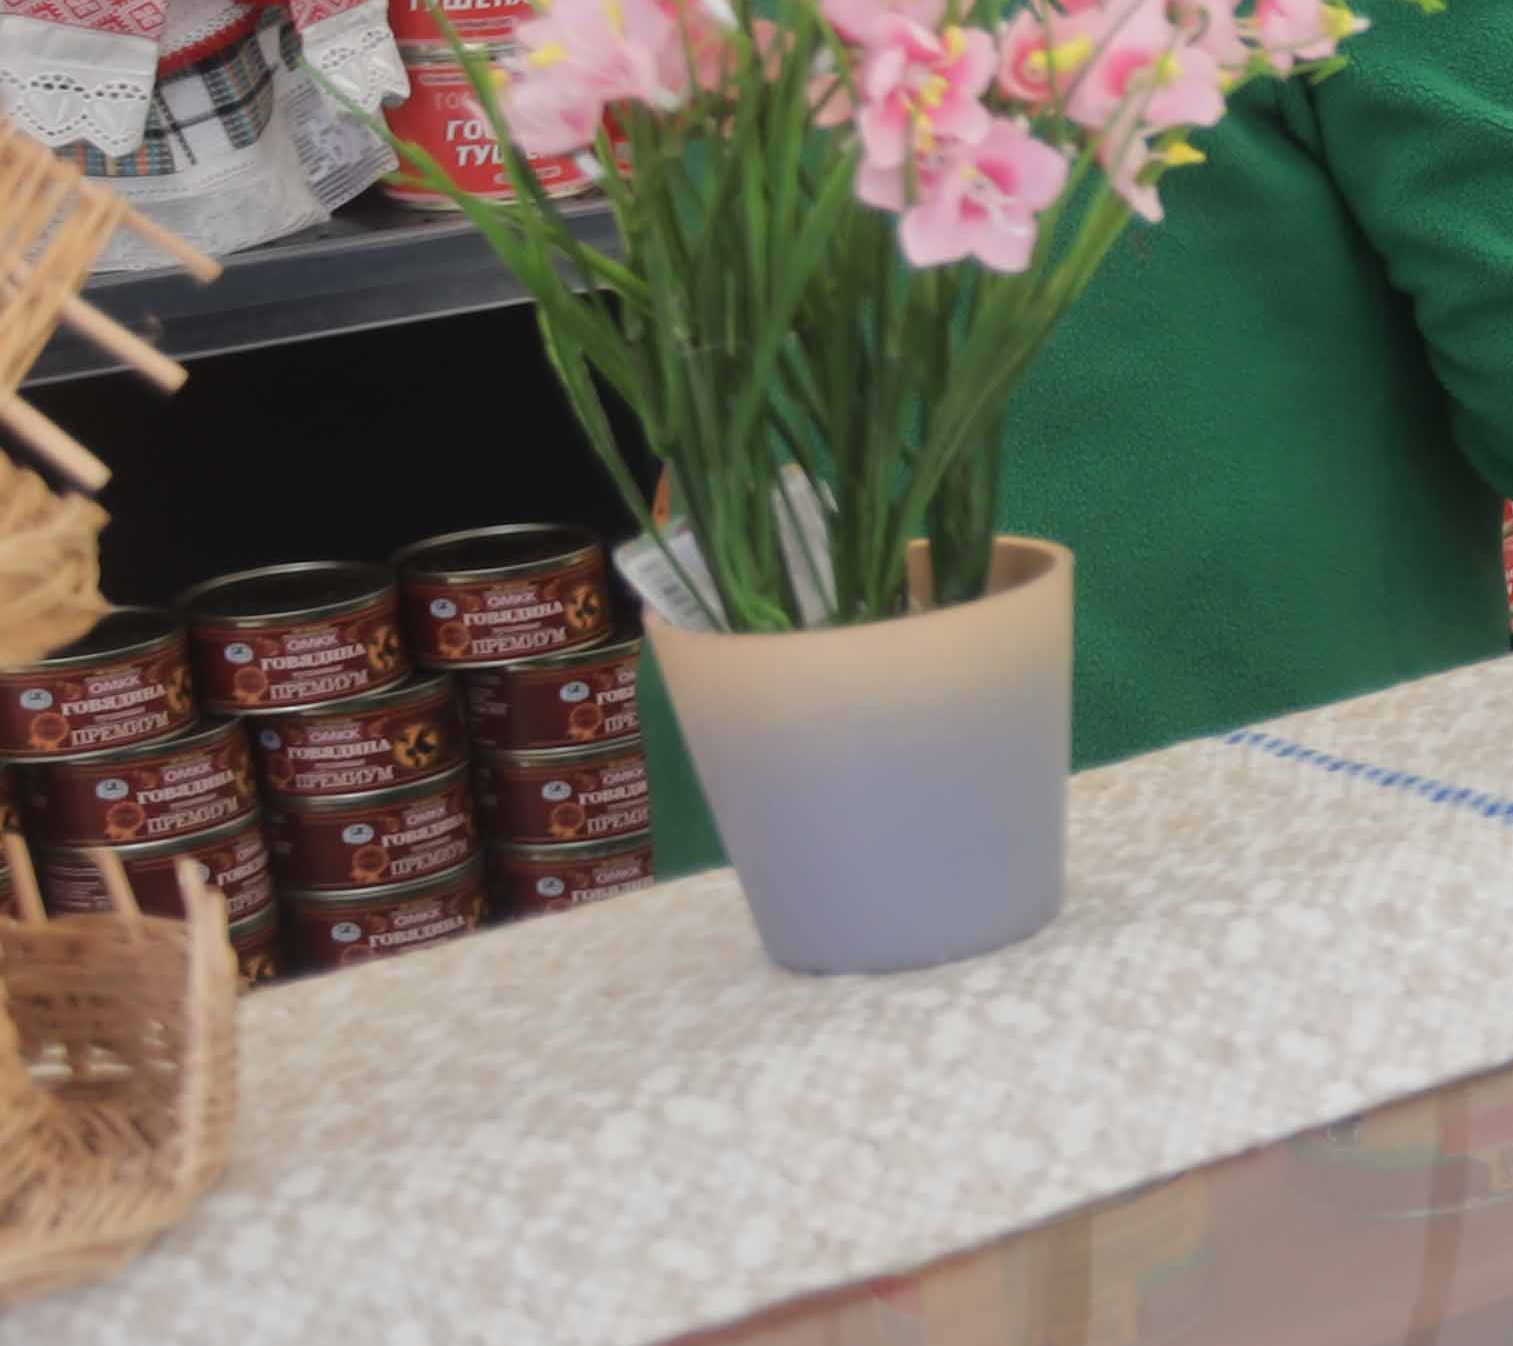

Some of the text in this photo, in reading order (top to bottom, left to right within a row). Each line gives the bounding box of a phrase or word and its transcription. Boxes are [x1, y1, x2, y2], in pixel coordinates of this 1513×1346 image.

[471, 626, 567, 655] ПРЕМИУМ
[270, 668, 369, 700] ПРЕМИУМ
[70, 711, 170, 746] ПРЕМИУМ
